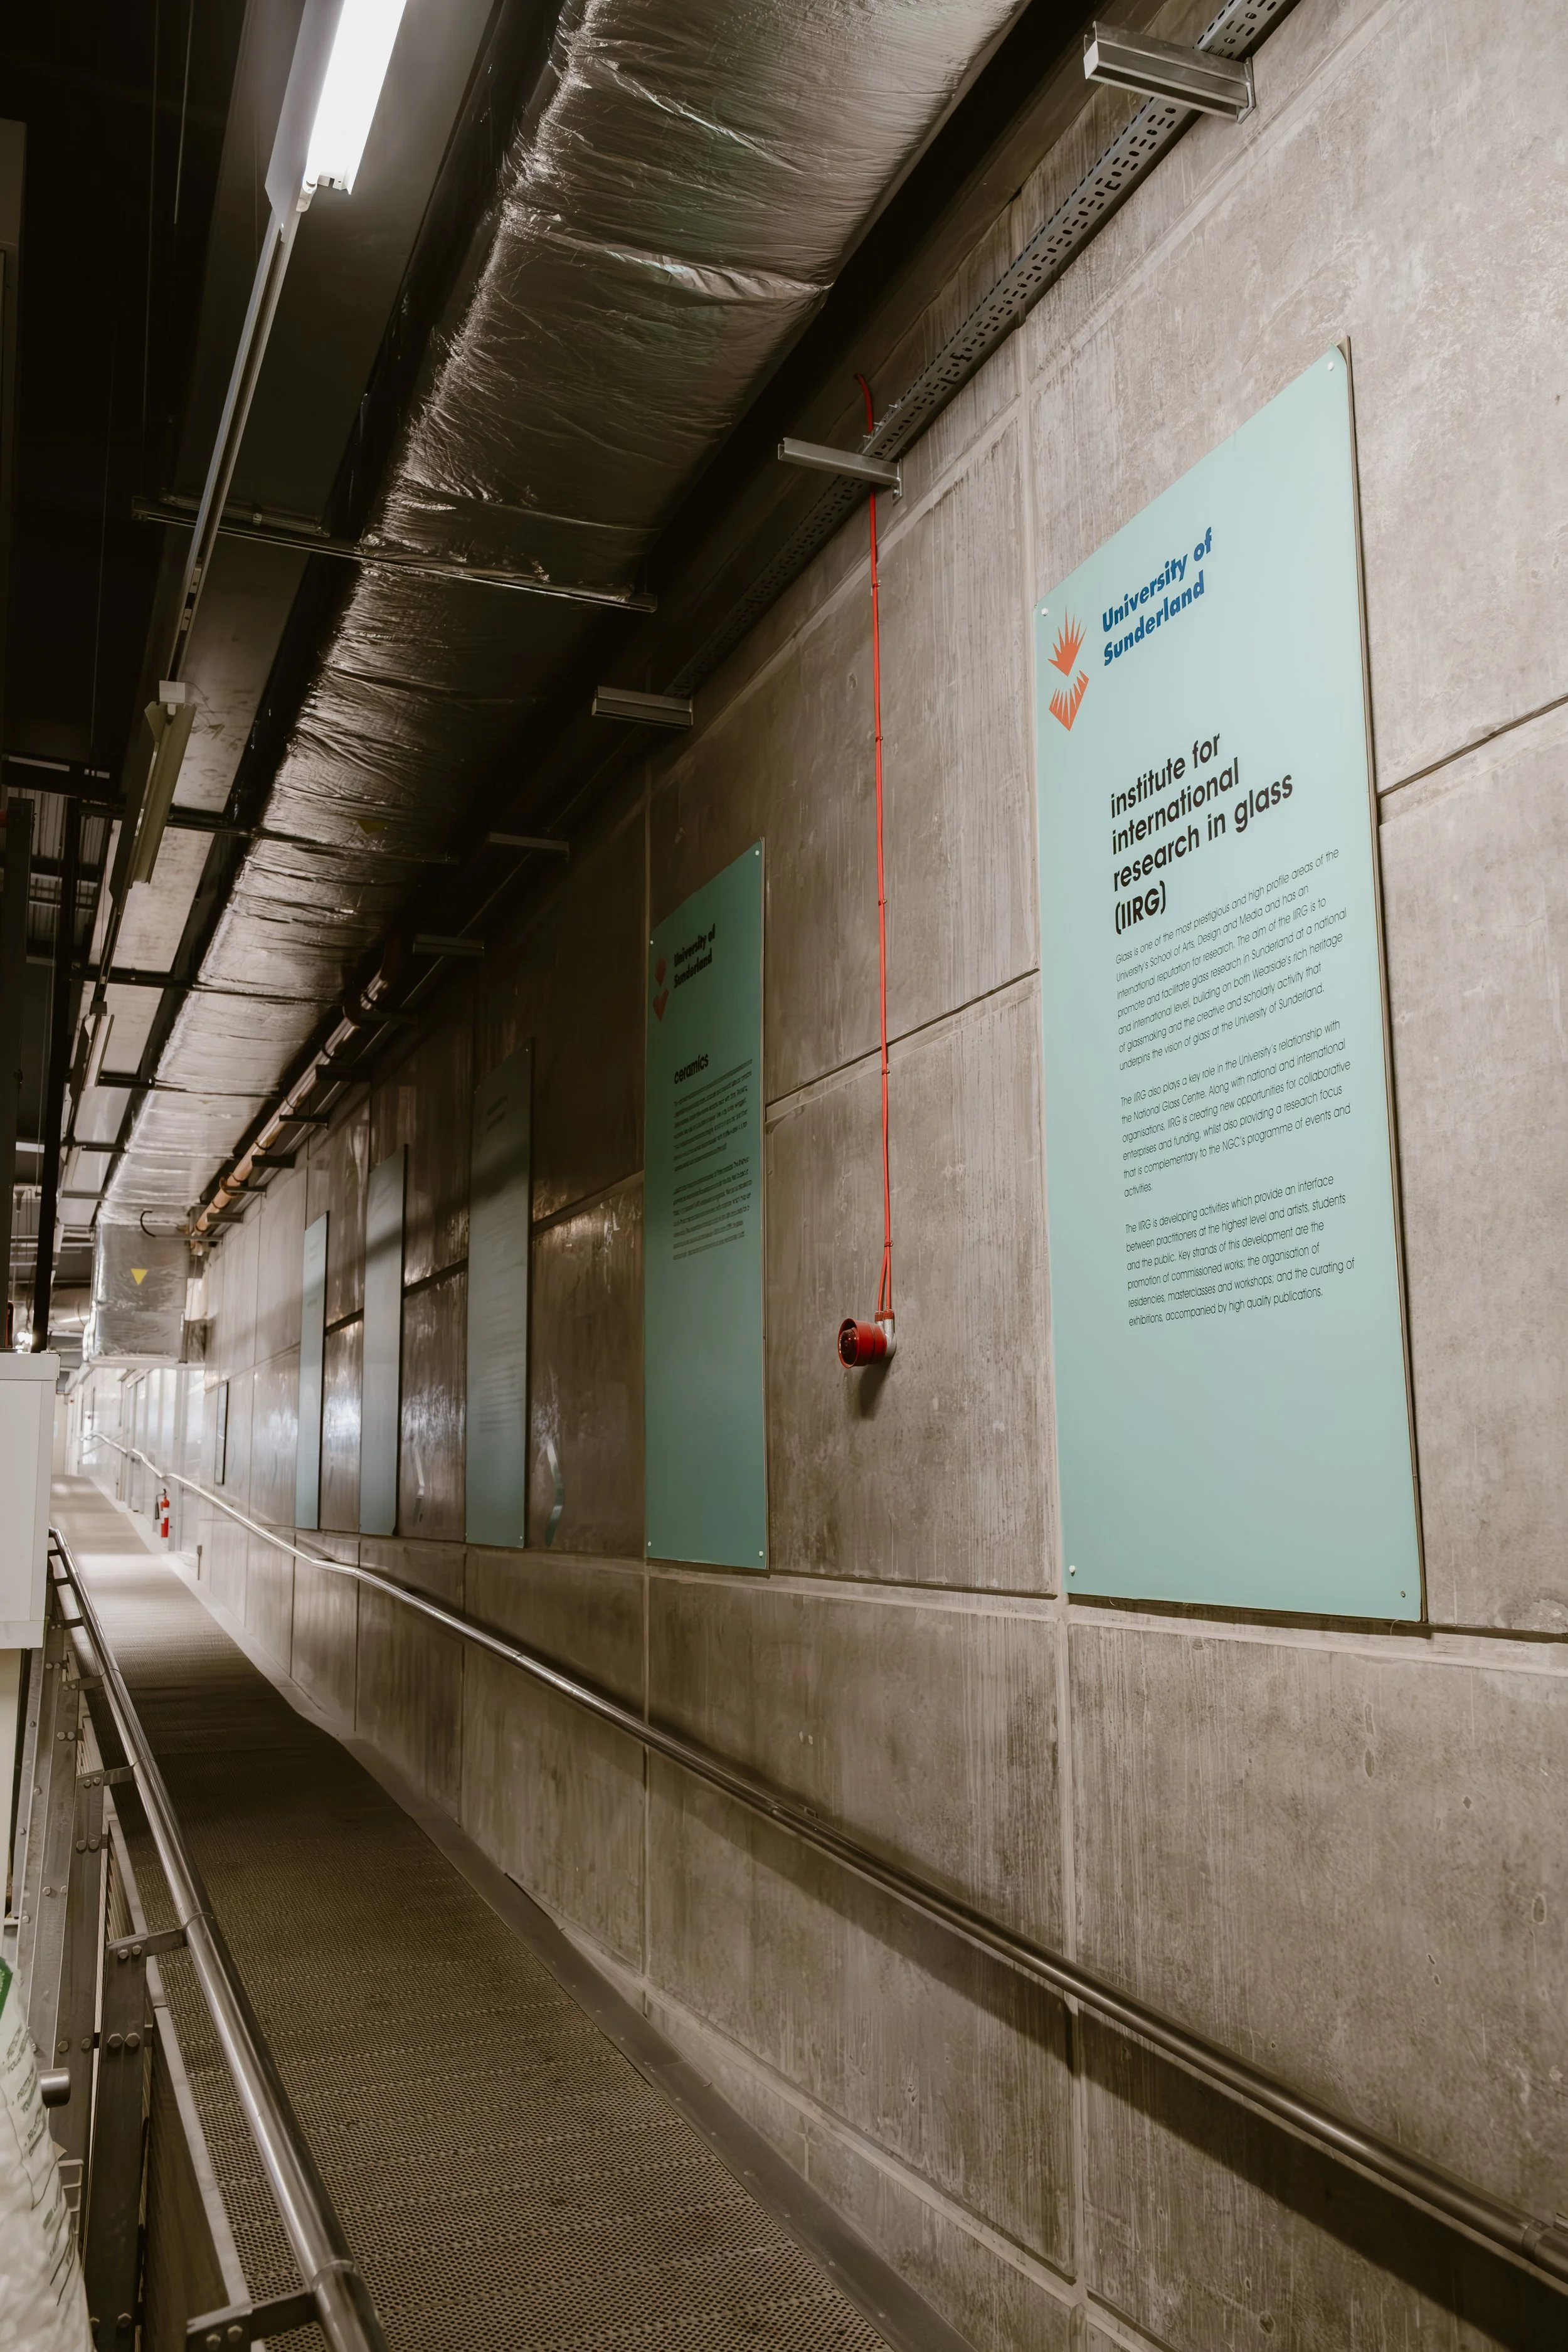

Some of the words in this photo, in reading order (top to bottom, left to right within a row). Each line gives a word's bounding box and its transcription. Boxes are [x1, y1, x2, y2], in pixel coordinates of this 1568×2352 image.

[1102, 553, 1188, 633] University
[1193, 526, 1212, 562] of
[1103, 569, 1205, 667] Sunderland
[1111, 757, 1186, 819] institute
[1192, 733, 1221, 770] for
[1112, 756, 1239, 856] international
[1113, 824, 1200, 893] research
[1207, 813, 1226, 842] in
[1234, 774, 1293, 834] glass
[1115, 950, 1133, 965] Glass
[1133, 947, 1139, 956] is
[1140, 941, 1153, 953] one
[1154, 935, 1162, 946] of
[1162, 931, 1174, 943] the
[1175, 920, 1192, 937] most
[1194, 904, 1230, 931] prestigious
[1231, 893, 1247, 909] and
[1248, 886, 1264, 901] high
[1266, 874, 1290, 895] profile
[1291, 862, 1313, 880] areas
[1315, 853, 1323, 867] of
[1325, 849, 1339, 862] the
[1115, 880, 1167, 935] (IIRG)
[1116, 961, 1149, 982] University's
[1150, 948, 1172, 967] School
[1173, 944, 1181, 956] of
[1182, 940, 1195, 953] Arts,
[1197, 928, 1221, 946] Design
[1222, 918, 1237, 933] and
[1239, 908, 1263, 926] Media
[1264, 897, 1281, 913] and
[1282, 891, 1296, 906] has
[1298, 885, 1309, 897] an
[674, 935, 706, 967] University
[674, 947, 712, 988] Sunderland
[1116, 975, 1155, 1000] international
[1157, 961, 1191, 982] reputation
[1192, 956, 1201, 967] for
[1203, 941, 1236, 962] research.
[1237, 934, 1250, 946] The
[1251, 926, 1266, 940] aim
[1268, 919, 1276, 932] of
[1278, 913, 1291, 928] the
[1293, 904, 1308, 921] IIRG
[1310, 902, 1316, 913] is
[1317, 898, 1327, 909] to
[1118, 1022, 1131, 1036] and
[1132, 1005, 1172, 1030] international
[1173, 997, 1191, 1013] level,
[1193, 987, 1221, 1005] building
[1222, 982, 1232, 992] on
[1233, 973, 1251, 988] both
[1252, 955, 1291, 980] Wearside's
[1293, 948, 1308, 962] rich
[1309, 933, 1343, 955] heritage
[1119, 1052, 1151, 1071] underpins
[1152, 1048, 1163, 1059] the
[1164, 1041, 1183, 1054] vision
[1184, 1035, 1192, 1047] of
[1192, 1030, 1210, 1046] glass
[1212, 1024, 1220, 1036] at
[1221, 1021, 1233, 1032] the
[1234, 1007, 1268, 1027] University
[1269, 1000, 1277, 1014] of
[1278, 982, 1325, 1010] Sunderland.
[1120, 1096, 1132, 1107] The
[1133, 1089, 1147, 1103] IIRG
[1147, 1086, 1162, 1098] also
[1163, 1079, 1180, 1094] plays
[1182, 1077, 1187, 1086] a
[1189, 1072, 1201, 1084] key
[1202, 1066, 1216, 1079] role
[1217, 1064, 1224, 1074] in
[1224, 1059, 1237, 1071] the
[1239, 1043, 1277, 1066] University's
[1278, 1027, 1323, 1051] relationship
[1324, 1019, 1340, 1034] with
[674, 1054, 709, 1084] ceramics
[1121, 1115, 1132, 1125] the
[1133, 1103, 1161, 1121] National
[1162, 1098, 1180, 1111] Glass
[1181, 1090, 1207, 1105] Centre.
[1208, 1082, 1229, 1097] Along
[1231, 1075, 1246, 1088] with
[1247, 1062, 1277, 1083] national
[1278, 1056, 1295, 1072] and
[1296, 1038, 1346, 1066] international
[1123, 1144, 1157, 1161] enterprises
[1158, 1137, 1172, 1150] and
[1173, 1131, 1201, 1146] funding,
[1203, 1122, 1222, 1137] whilst
[1223, 1119, 1238, 1131] also
[1239, 1108, 1274, 1128] providing
[1276, 1105, 1282, 1115] a
[1284, 1092, 1318, 1112] research
[1320, 1085, 1343, 1101] focus
[1123, 1167, 1136, 1179] that
[1137, 1165, 1143, 1175] is
[1143, 1151, 1199, 1173] complementary
[1199, 1147, 1207, 1158] to
[1208, 1144, 1221, 1155] the
[1222, 1135, 1246, 1152] NGC's
[1247, 1123, 1293, 1147] programme
[1295, 1116, 1303, 1130] of
[1305, 1110, 1332, 1126] events
[1333, 1102, 1351, 1118] and
[1124, 1183, 1153, 1197] activities.
[1125, 1224, 1137, 1234] The
[1138, 1219, 1152, 1231] IIRG
[1152, 1217, 1158, 1228] is
[1158, 1209, 1197, 1226] developing
[1199, 1202, 1229, 1217] activities
[1231, 1195, 1253, 1209] which
[1254, 1187, 1283, 1206] provide
[1285, 1185, 1296, 1196] an
[1297, 1175, 1334, 1193] interface
[1126, 1239, 1155, 1253] between
[1156, 1229, 1197, 1248] practitioners
[1199, 1225, 1206, 1237] at
[1207, 1224, 1220, 1235] the
[1221, 1216, 1248, 1233] highest
[1249, 1211, 1267, 1226] level
[1269, 1207, 1285, 1221] and
[1286, 1202, 1310, 1217] artists,
[1312, 1193, 1346, 1211] students
[1126, 1259, 1140, 1271] and
[1141, 1258, 1153, 1268] the
[1154, 1252, 1177, 1268] public.
[1178, 1249, 1191, 1261] Key
[1192, 1244, 1217, 1258] strands
[1219, 1241, 1227, 1253] of
[1228, 1239, 1241, 1251] this
[1241, 1226, 1293, 1248] development
[1295, 1225, 1309, 1236] are
[1310, 1221, 1325, 1232] the
[1128, 1293, 1166, 1308] residencies,
[1167, 1285, 1216, 1301] masterclasses
[1217, 1280, 1232, 1293] and
[1234, 1274, 1274, 1290] workshops;
[1276, 1269, 1293, 1283] and
[1294, 1268, 1308, 1279] the
[1310, 1261, 1344, 1276] curating
[1346, 1256, 1355, 1270] of
[1128, 1313, 1163, 1327] exhibitions,
[1165, 1303, 1216, 1321] accompanied
[1217, 1302, 1227, 1315] by
[1228, 1298, 1245, 1313] high
[1246, 1295, 1272, 1310] quality
[1273, 1288, 1323, 1307] publications.
